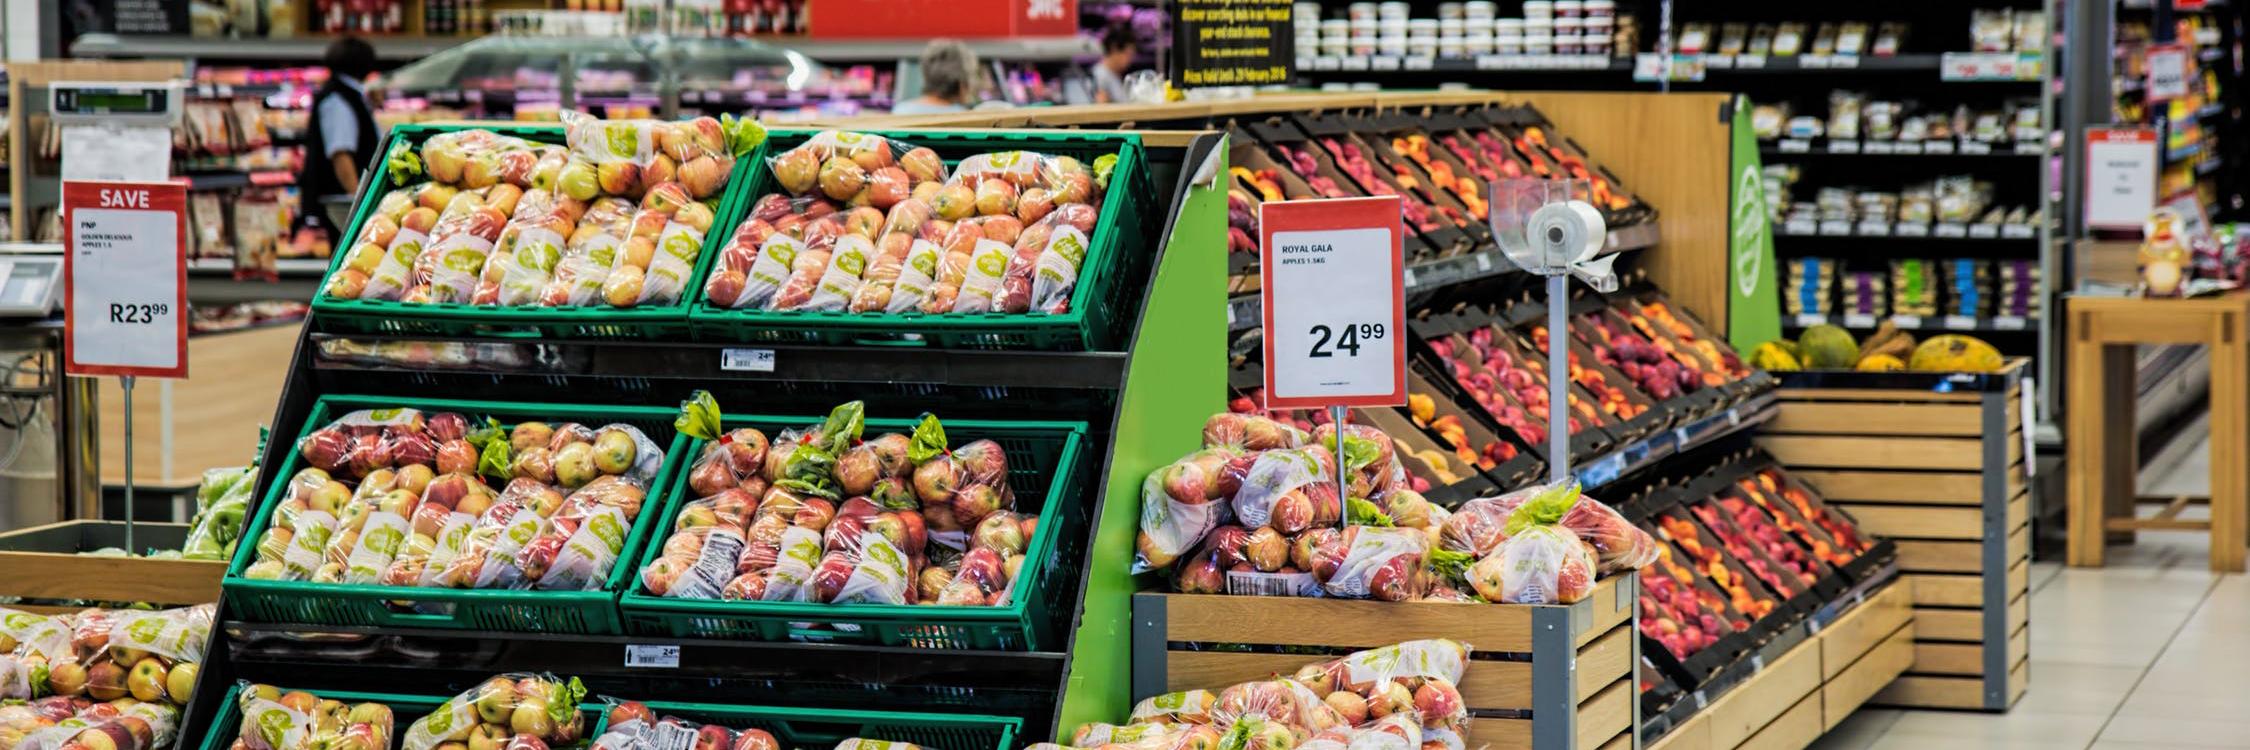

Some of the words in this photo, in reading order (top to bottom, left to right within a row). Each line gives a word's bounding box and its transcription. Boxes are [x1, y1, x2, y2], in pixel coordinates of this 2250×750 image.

[100, 188, 150, 209] SAVE
[81, 221, 96, 230] PNP
[81, 233, 103, 241] GOLDEN
[1282, 244, 1309, 254] ROYAL
[1311, 243, 1333, 253] GALA
[1282, 257, 1305, 265] APPLES
